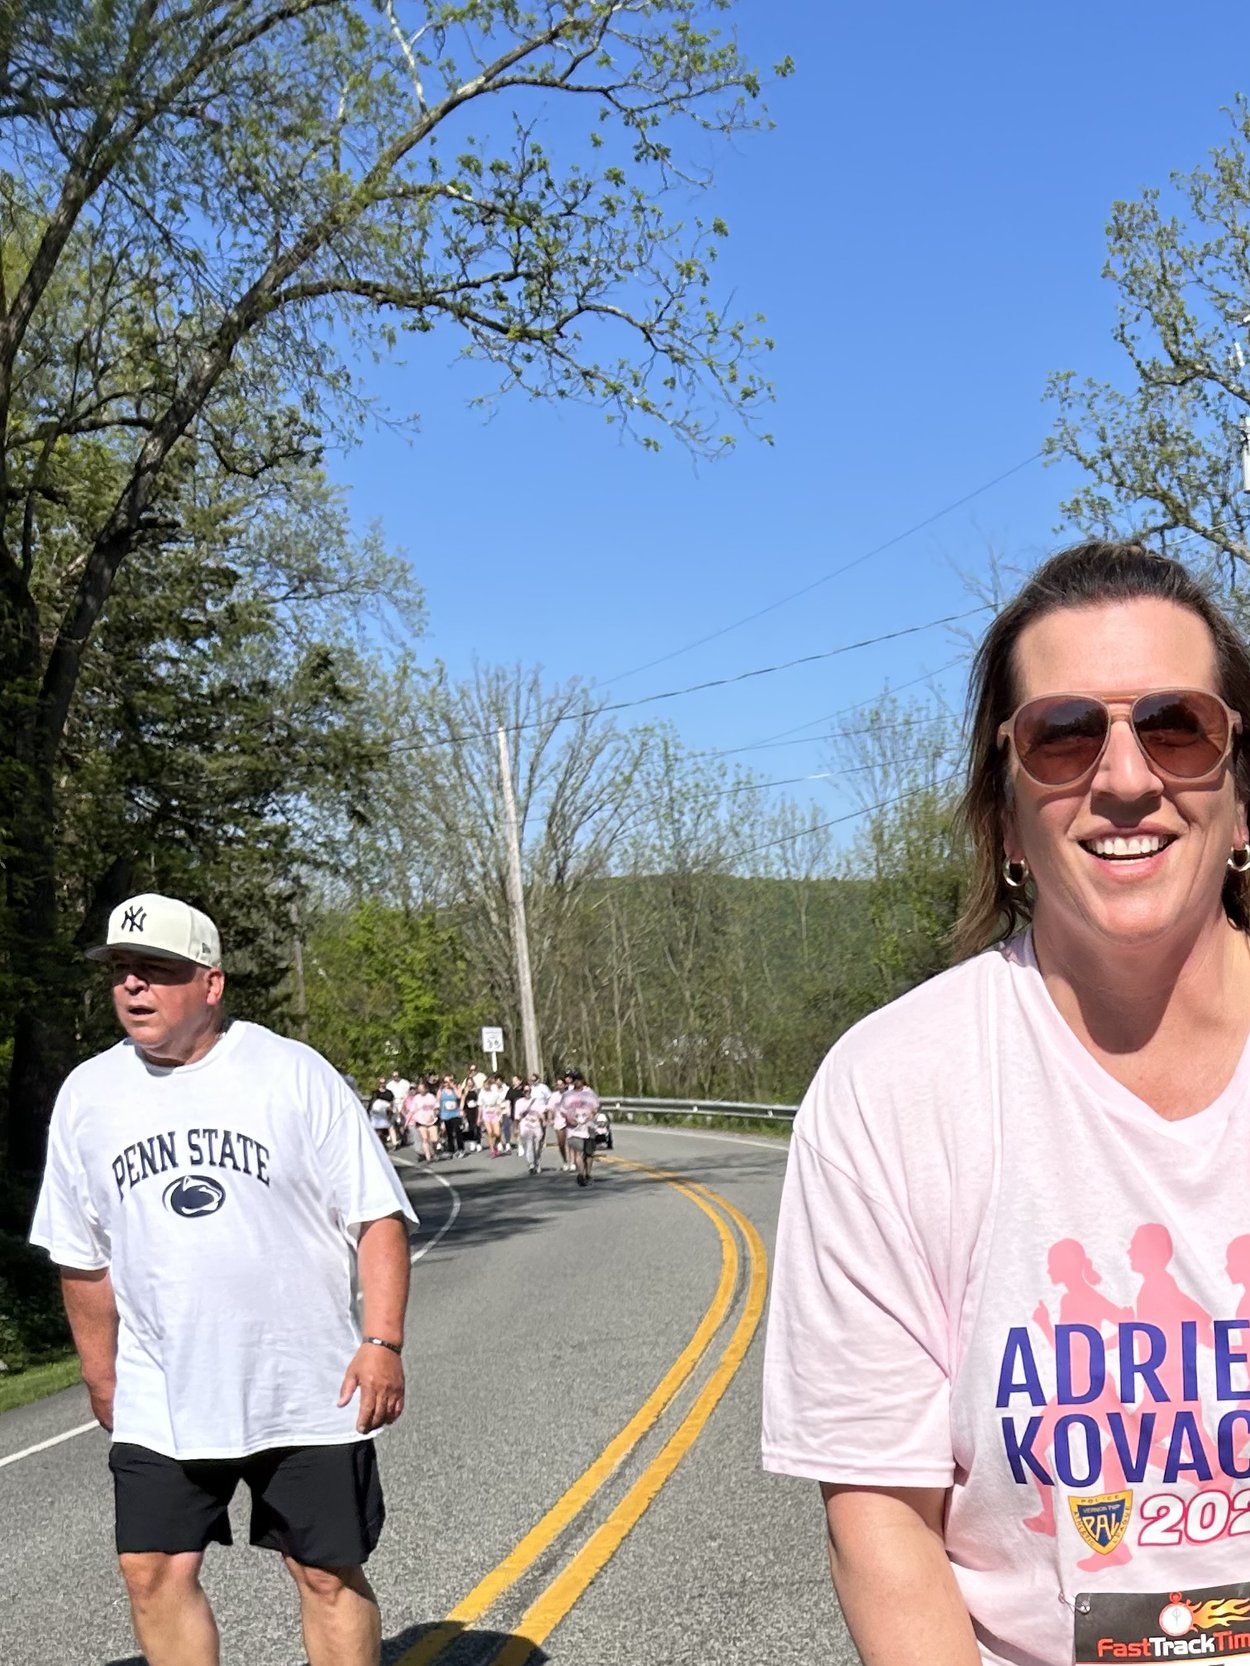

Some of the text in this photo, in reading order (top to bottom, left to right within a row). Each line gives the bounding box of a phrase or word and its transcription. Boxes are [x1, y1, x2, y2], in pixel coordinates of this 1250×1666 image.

[121, 905, 147, 932] NY
[112, 1128, 271, 1202] PENN STATE
[1082, 1513, 1120, 1542] PAL
